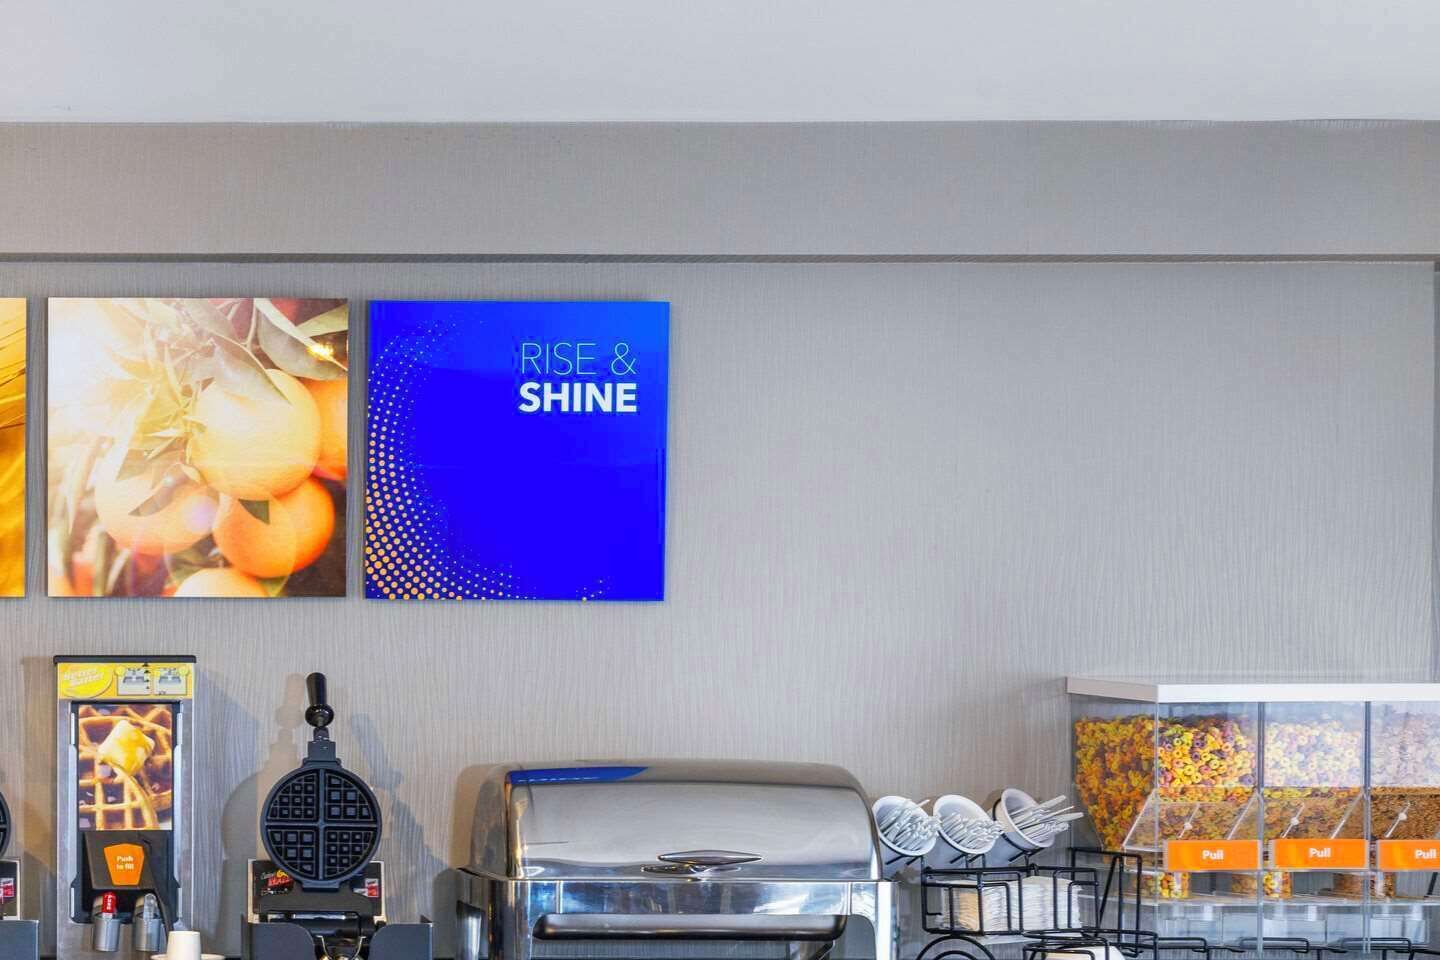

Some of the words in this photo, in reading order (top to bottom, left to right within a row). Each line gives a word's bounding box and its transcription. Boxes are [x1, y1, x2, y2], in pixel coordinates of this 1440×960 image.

[521, 342, 597, 376] RISE
[610, 342, 637, 376] &
[518, 381, 637, 413] SHINE
[1202, 849, 1224, 860] Pull
[1309, 847, 1331, 858] Pull
[1415, 848, 1437, 859] Pull
